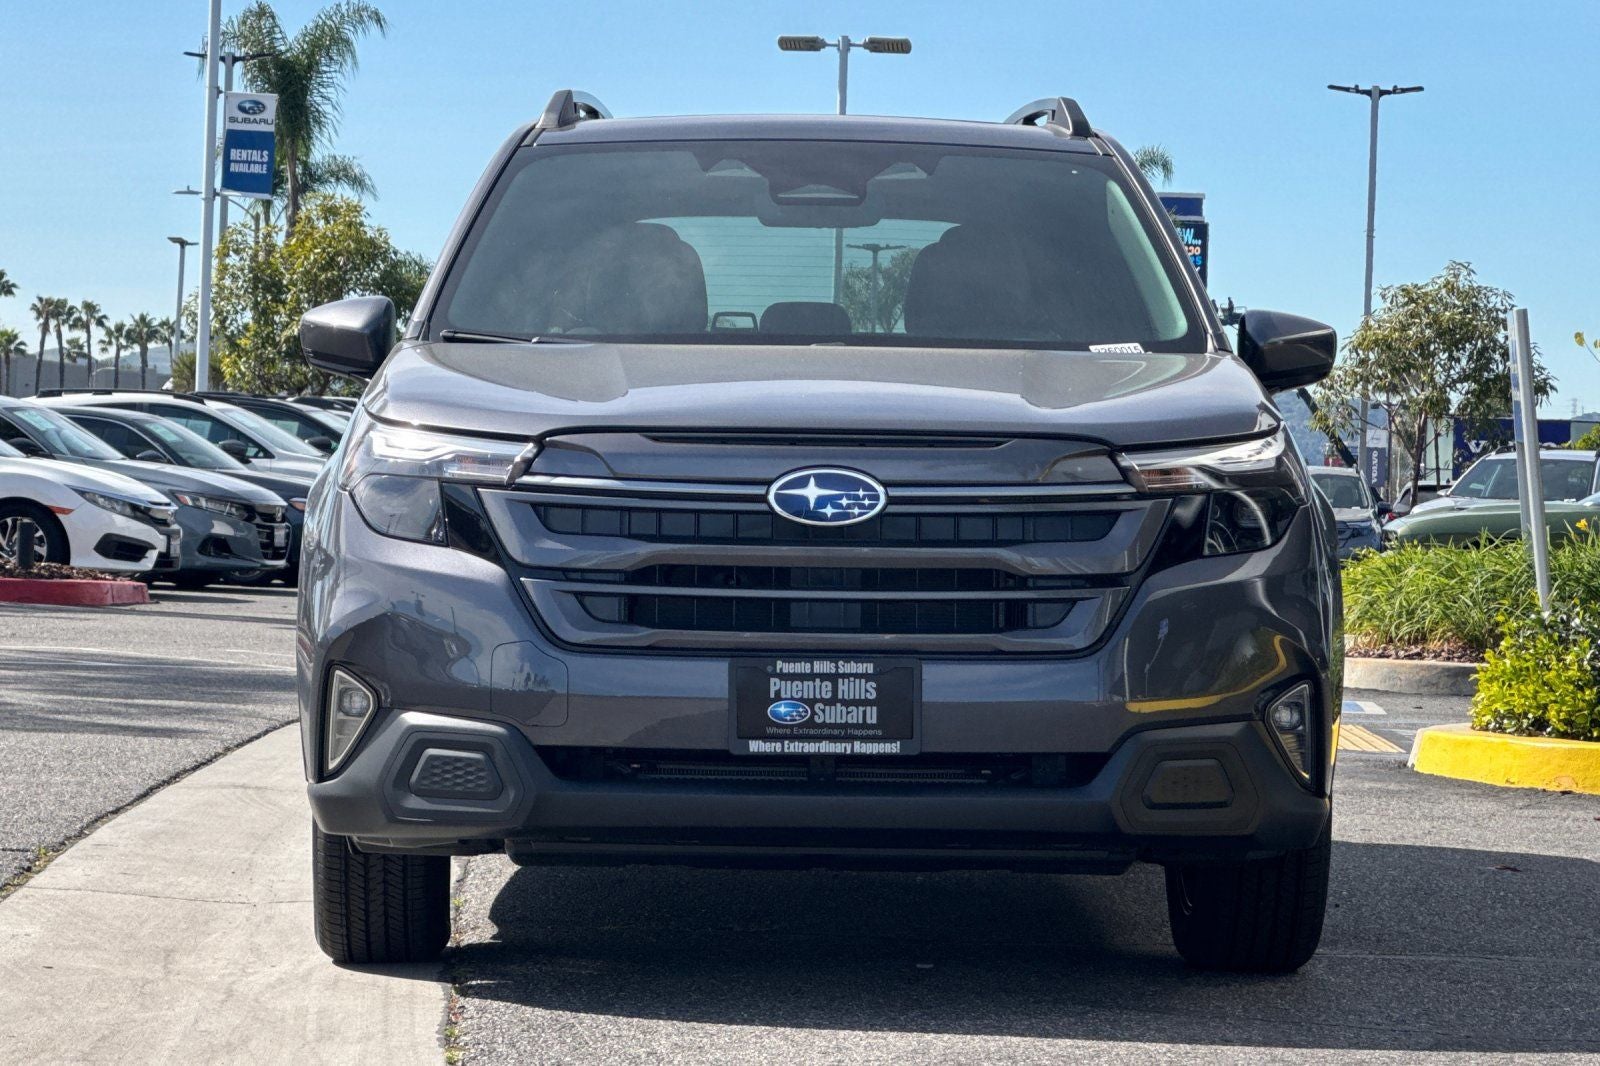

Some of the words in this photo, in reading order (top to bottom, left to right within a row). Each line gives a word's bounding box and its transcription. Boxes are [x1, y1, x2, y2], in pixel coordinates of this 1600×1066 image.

[228, 116, 274, 125] SUBARU
[230, 148, 269, 162] RENTALS
[229, 162, 267, 174] AVAILABLE
[1371, 450, 1379, 484] VOLVO
[776, 660, 811, 674] Puente
[813, 660, 836, 674] Hills
[837, 660, 874, 674] Subaru
[769, 677, 832, 699] Puente
[837, 678, 877, 700] Hills
[813, 703, 877, 724] Subaru
[766, 726, 791, 735] Where
[793, 726, 846, 737] Extraordinary
[847, 727, 883, 737] Happens
[749, 740, 782, 753] Where
[783, 740, 851, 755] Extraordinary
[853, 740, 901, 755] Happens!
